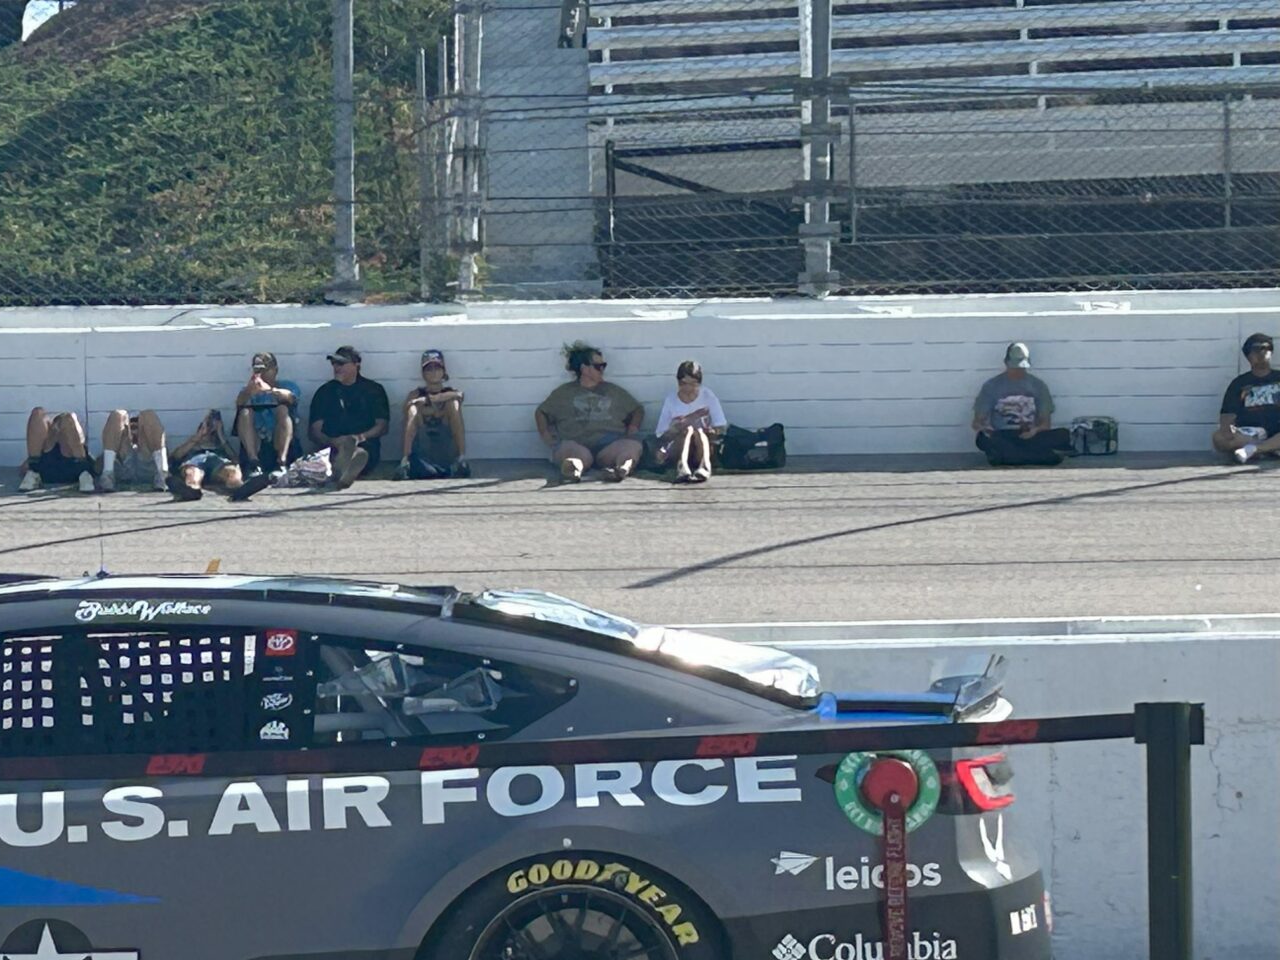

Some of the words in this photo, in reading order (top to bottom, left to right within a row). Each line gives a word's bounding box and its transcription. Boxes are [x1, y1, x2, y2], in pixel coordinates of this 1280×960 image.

[208, 776, 392, 835] AIR
[421, 754, 803, 825] FORCE
[506, 859, 700, 946] GOODYEAR
